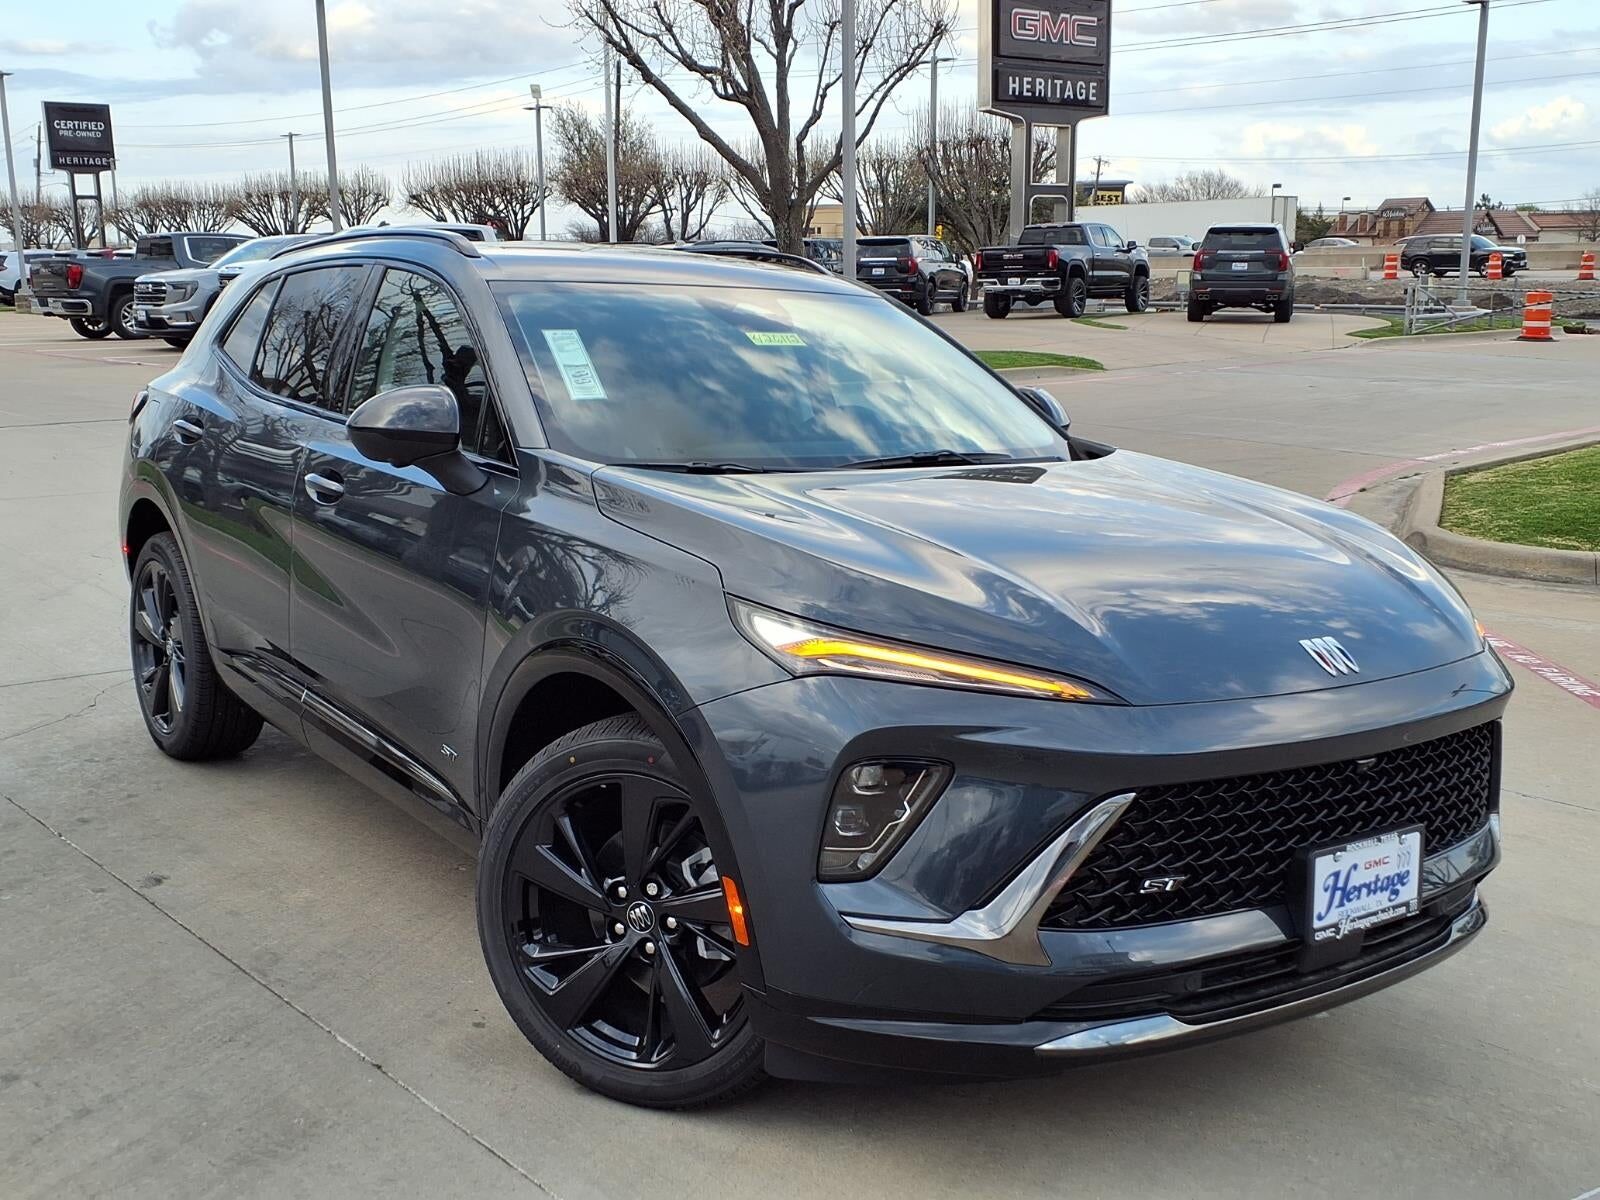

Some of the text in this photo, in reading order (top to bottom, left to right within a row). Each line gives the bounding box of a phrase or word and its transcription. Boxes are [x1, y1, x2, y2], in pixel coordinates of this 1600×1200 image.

[1011, 8, 1098, 47] GMC
[1008, 76, 1098, 101] HERITAGE
[53, 120, 105, 130] CERTIFIED
[59, 129, 102, 138] PRE-OWNED
[58, 156, 108, 166] HERITAGE
[1364, 856, 1391, 870] GMC
[1316, 862, 1410, 922] Heritage
[1314, 927, 1337, 941] GMC
